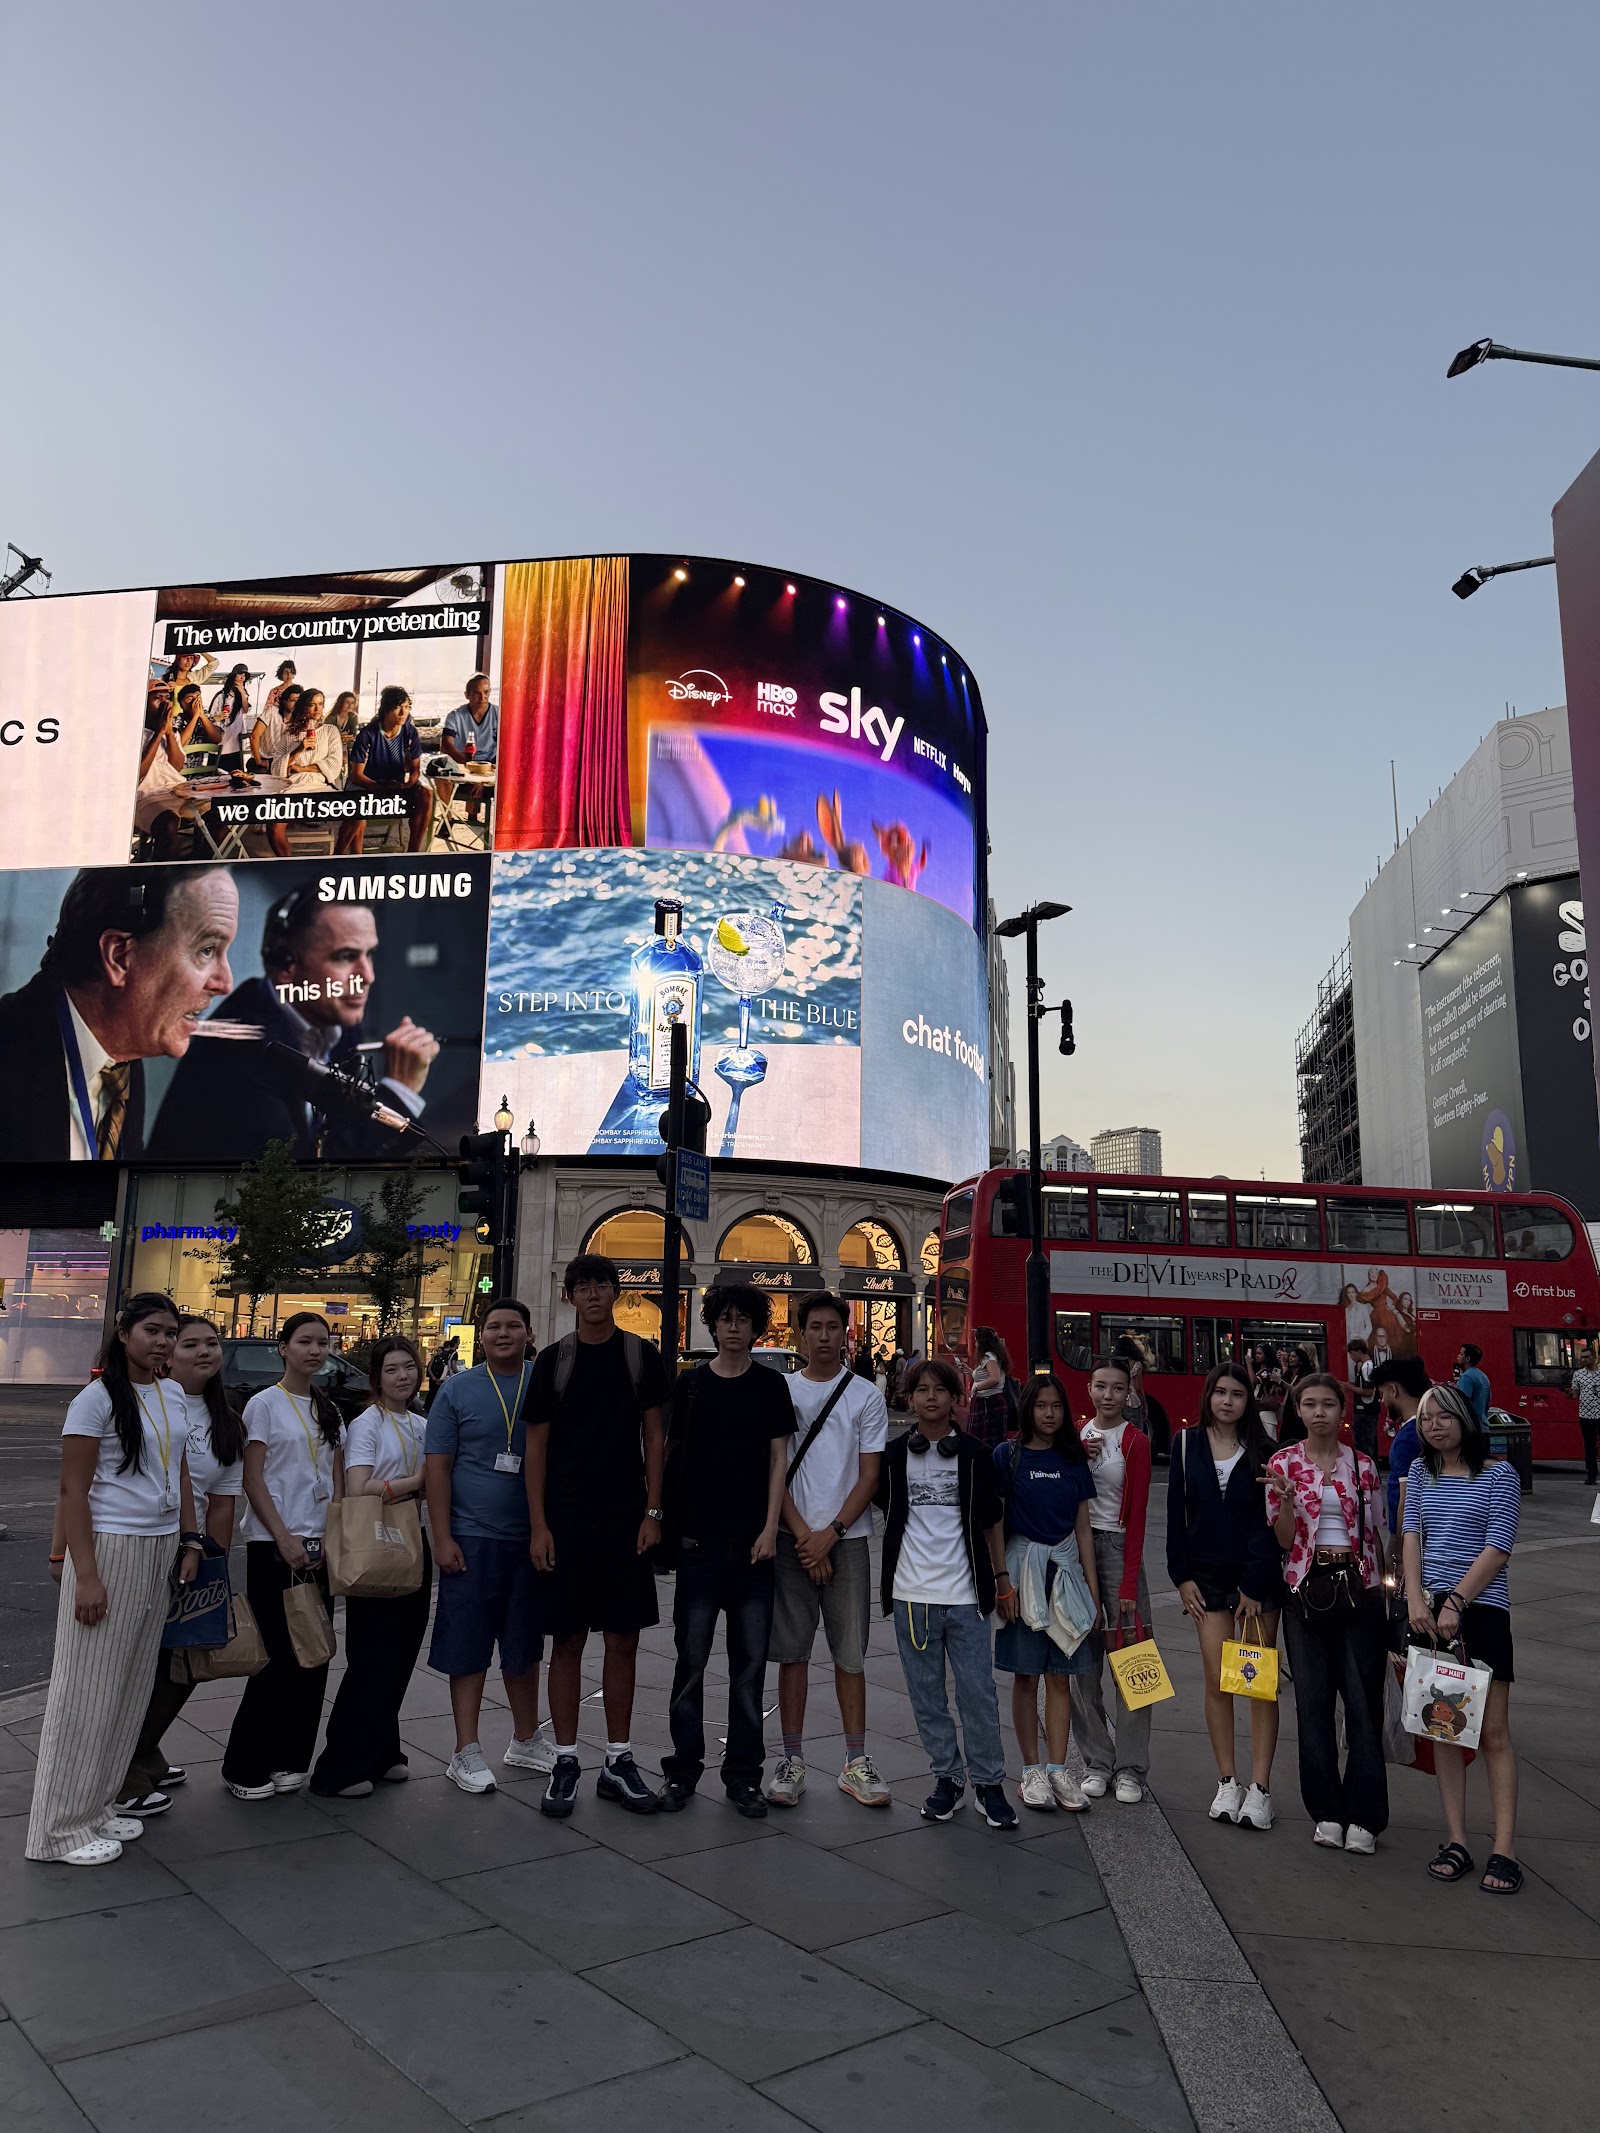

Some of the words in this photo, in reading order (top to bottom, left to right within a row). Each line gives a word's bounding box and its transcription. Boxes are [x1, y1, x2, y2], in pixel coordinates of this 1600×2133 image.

[174, 625, 212, 647] The
[215, 620, 277, 644] whole
[279, 616, 361, 640] country
[363, 607, 481, 639] pretending
[757, 681, 798, 705] HBO
[757, 699, 796, 718] max
[819, 686, 905, 762] sky
[913, 735, 947, 771] NETFLIX
[217, 804, 249, 822] we
[255, 797, 315, 820] didn't
[317, 799, 356, 818] see
[359, 793, 407, 816] that:
[318, 872, 472, 901] SAMSUNG
[275, 980, 321, 1004] This
[326, 976, 344, 998] is
[349, 974, 364, 995] it
[1436, 984, 1462, 1013] instrument
[498, 992, 558, 1013] STEP
[565, 991, 626, 1011] INTO
[1433, 1020, 1442, 1034] was
[1457, 994, 1471, 1016] could
[1472, 991, 1479, 1005] be
[756, 998, 800, 1021] THE
[807, 1003, 858, 1030] BLUE
[902, 1014, 951, 1056] chat
[1429, 1043, 1437, 1057] but
[1437, 1037, 1450, 1051] there
[1450, 1028, 1460, 1042] was
[1466, 1014, 1477, 1030] way
[1483, 993, 1507, 1018] shutting
[1432, 1092, 1449, 1110] George
[1433, 1109, 1456, 1129] Nineteen
[680, 1153, 693, 1165] BUS
[693, 1157, 707, 1169] LANE
[693, 1193, 708, 1205] BOTH
[141, 1222, 237, 1242] pharmacy
[406, 1221, 462, 1242] eauty
[618, 1268, 650, 1283] Lindt
[749, 1271, 783, 1286] Lindt
[1089, 1265, 1114, 1277] THE
[1112, 1258, 1196, 1286] DEVIL
[1186, 1269, 1226, 1281] WEARS
[1428, 1272, 1441, 1282] IN
[1443, 1273, 1493, 1284] CINEMAS
[863, 1276, 887, 1291] Lindt
[1437, 1284, 1473, 1297] MAY
[1477, 1285, 1484, 1298] 1
[1531, 1284, 1555, 1297] first
[1556, 1286, 1576, 1298] bus
[165, 1578, 228, 1624] Boots
[1127, 1668, 1158, 1686] TWG
[1437, 1666, 1448, 1674] POP
[1448, 1669, 1464, 1679] MART
